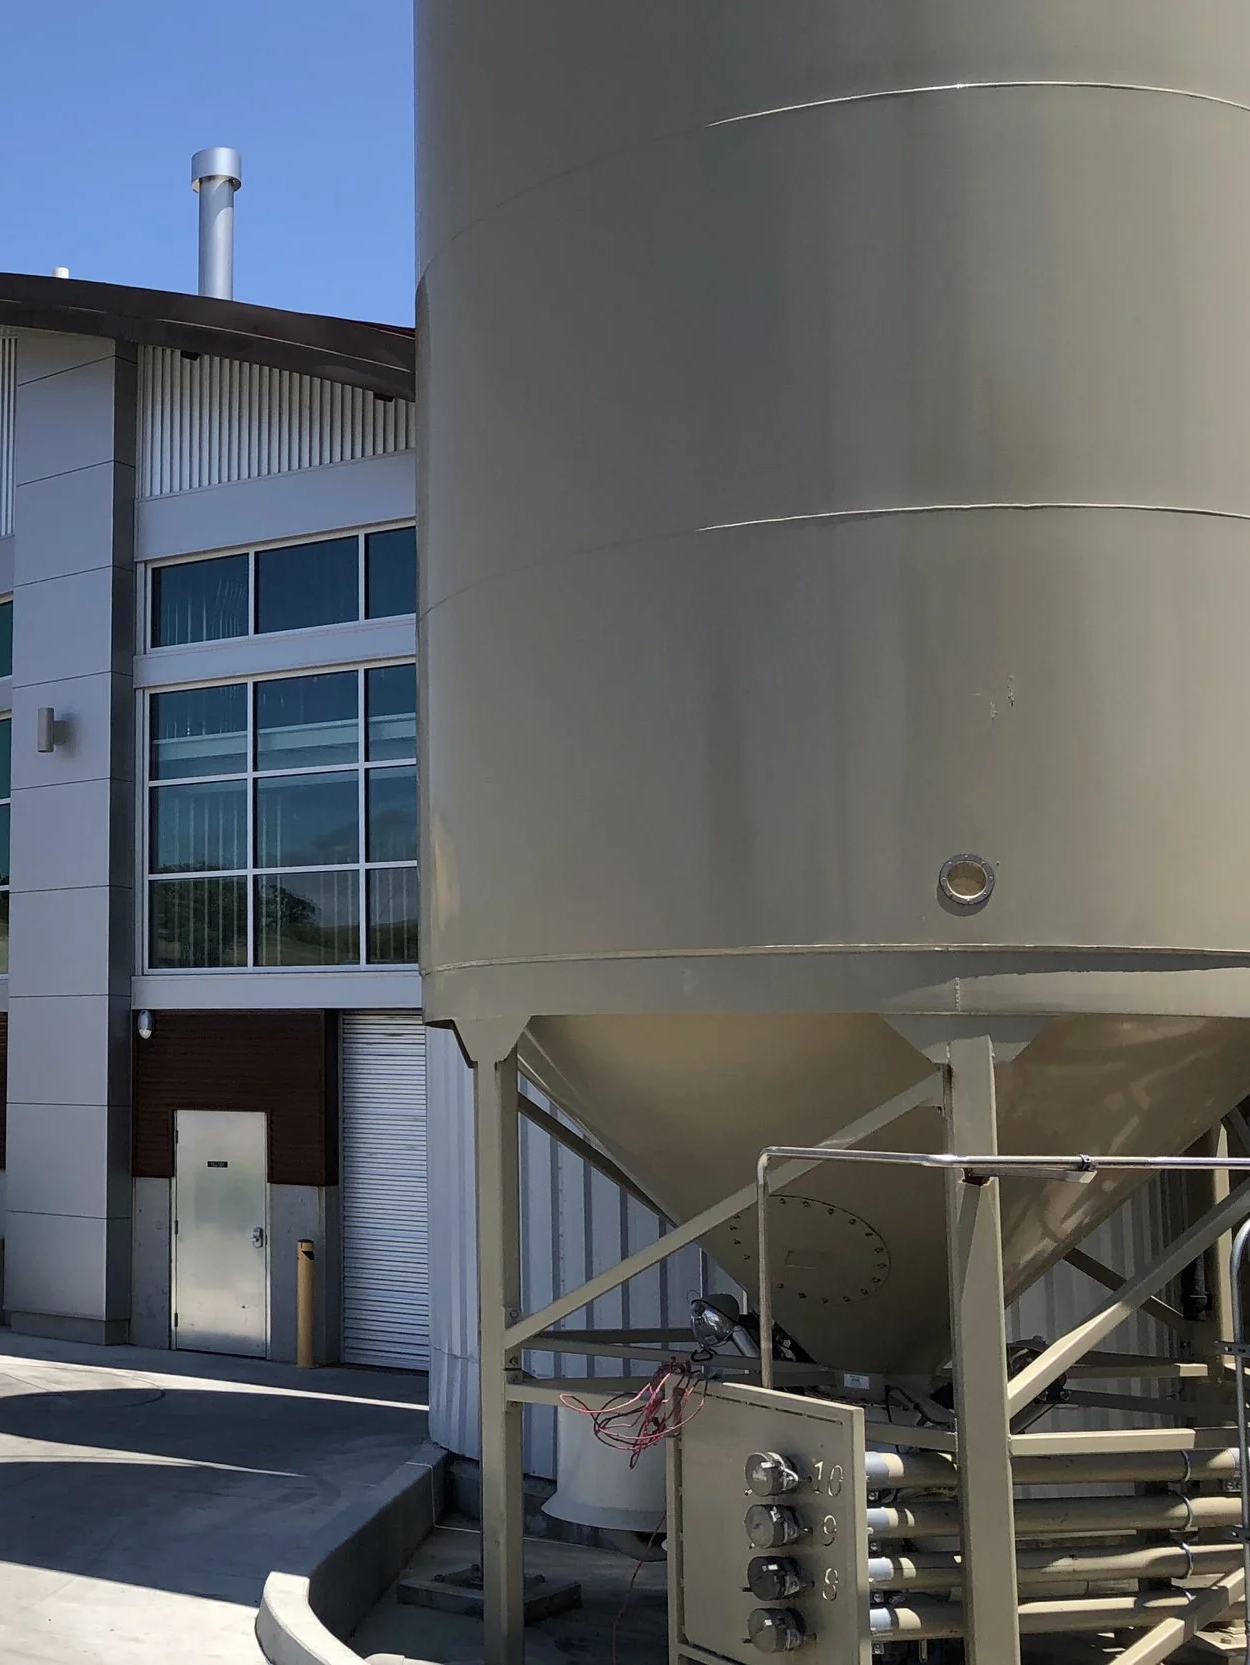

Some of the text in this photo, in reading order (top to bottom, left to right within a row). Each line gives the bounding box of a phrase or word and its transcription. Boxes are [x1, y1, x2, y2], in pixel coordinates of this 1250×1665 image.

[814, 1460, 844, 1497] 10
[822, 1515, 837, 1547] 9
[822, 1567, 838, 1601] 8
